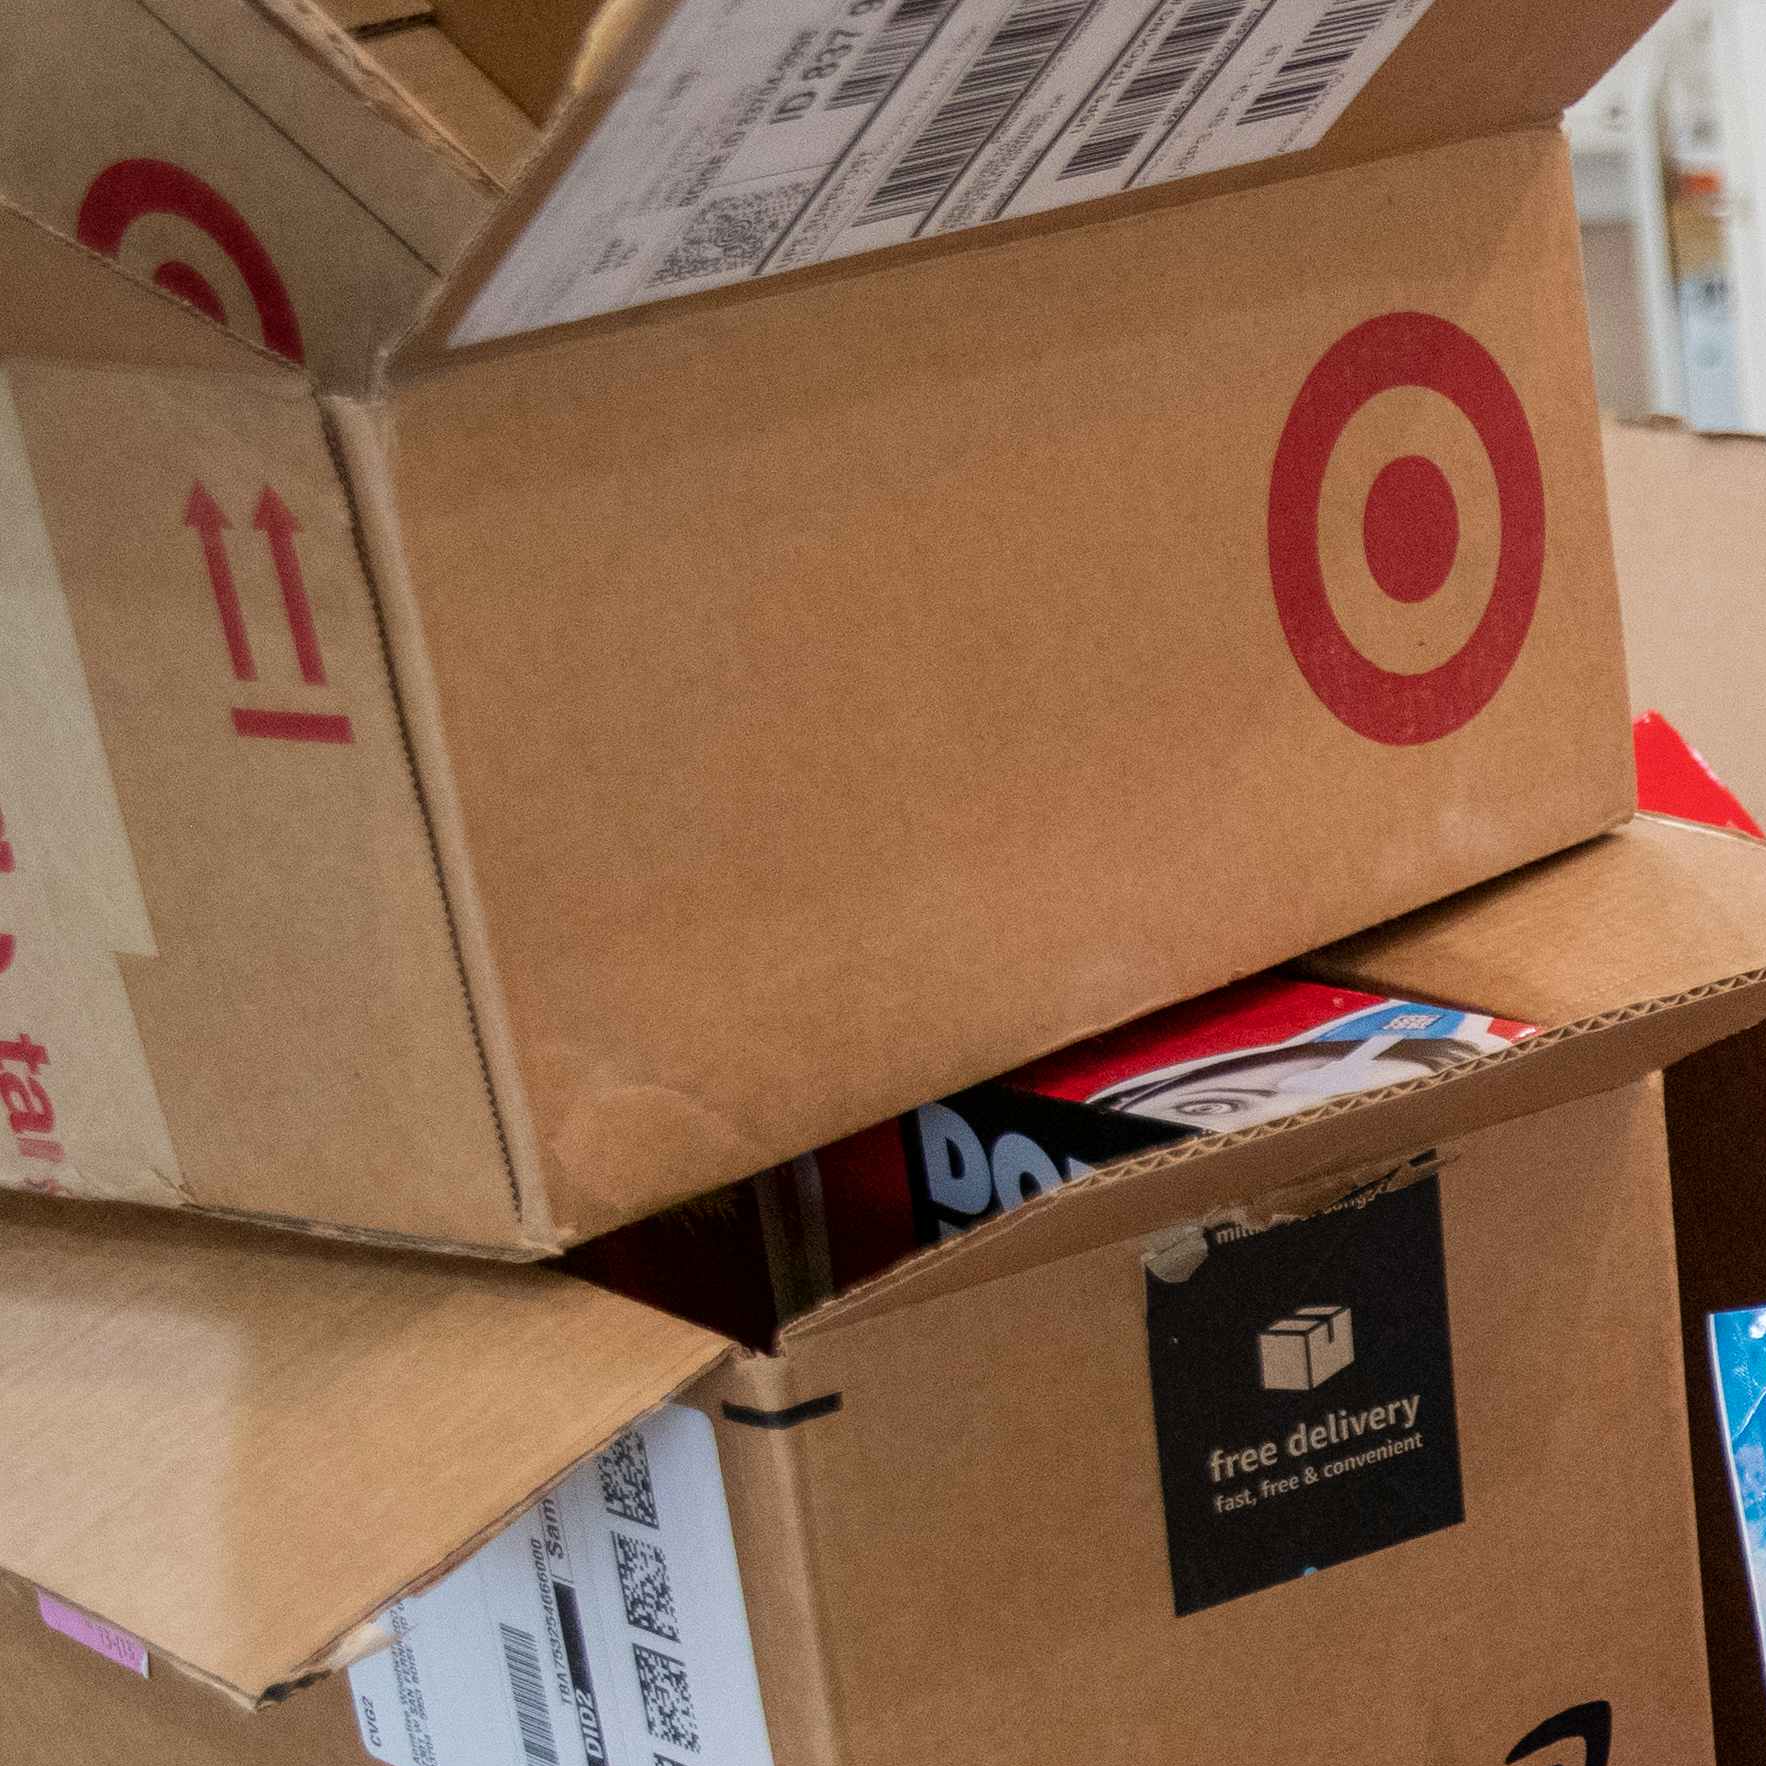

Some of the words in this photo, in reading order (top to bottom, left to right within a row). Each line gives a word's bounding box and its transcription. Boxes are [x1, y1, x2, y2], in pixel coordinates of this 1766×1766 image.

[1209, 1442, 1279, 1481] free
[1288, 1394, 1421, 1457] delivery
[1216, 1490, 1257, 1512] fast,
[1262, 1475, 1300, 1500] free
[1304, 1466, 1319, 1485] &
[1323, 1432, 1424, 1479] convenient
[359, 1696, 383, 1748] CVG2
[575, 1689, 605, 1758] DID2
